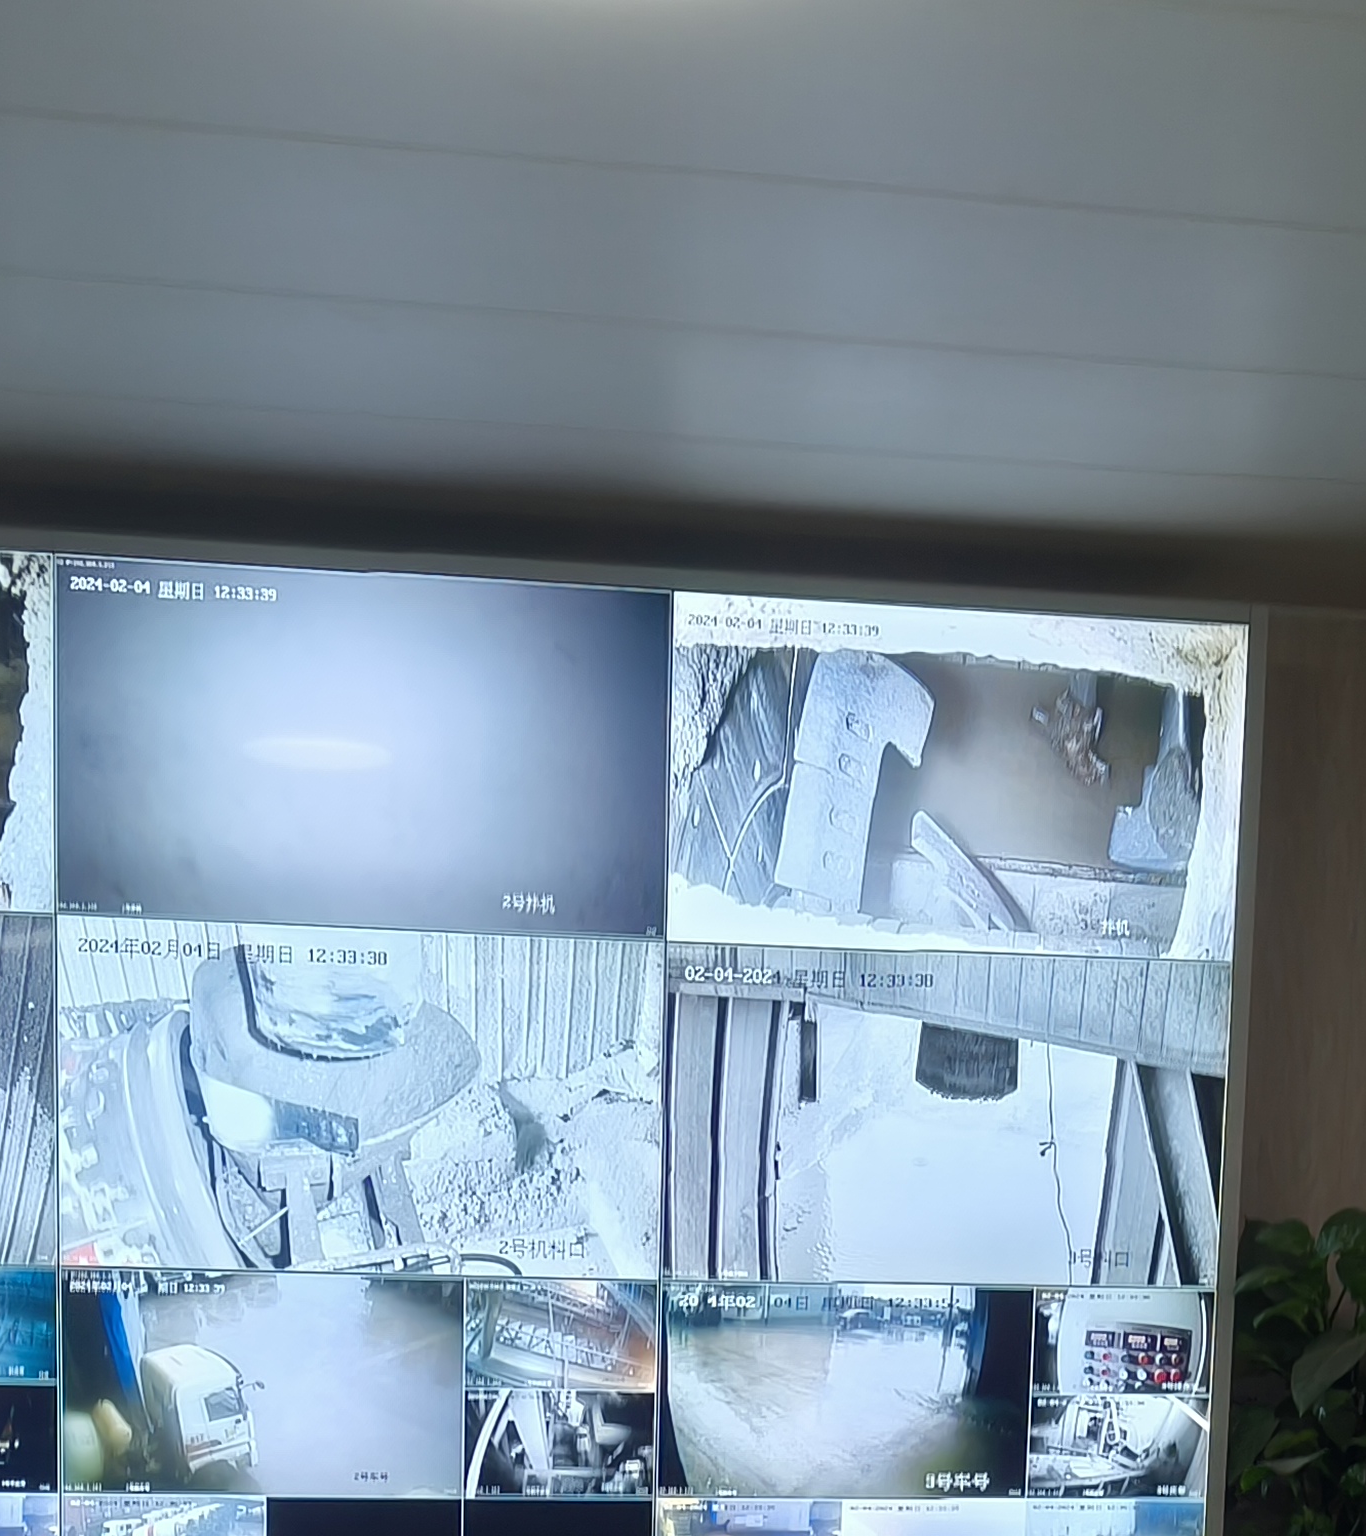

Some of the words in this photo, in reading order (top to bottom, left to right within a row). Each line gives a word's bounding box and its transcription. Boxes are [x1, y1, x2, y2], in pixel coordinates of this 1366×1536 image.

[70, 576, 151, 594] 2024-02-04
[158, 580, 204, 600] 星期日
[214, 585, 277, 601] 12:33:39
[823, 622, 879, 637] 12:33:39
[78, 937, 221, 961] 2024年02月04日
[684, 965, 781, 985] 02-04-2024
